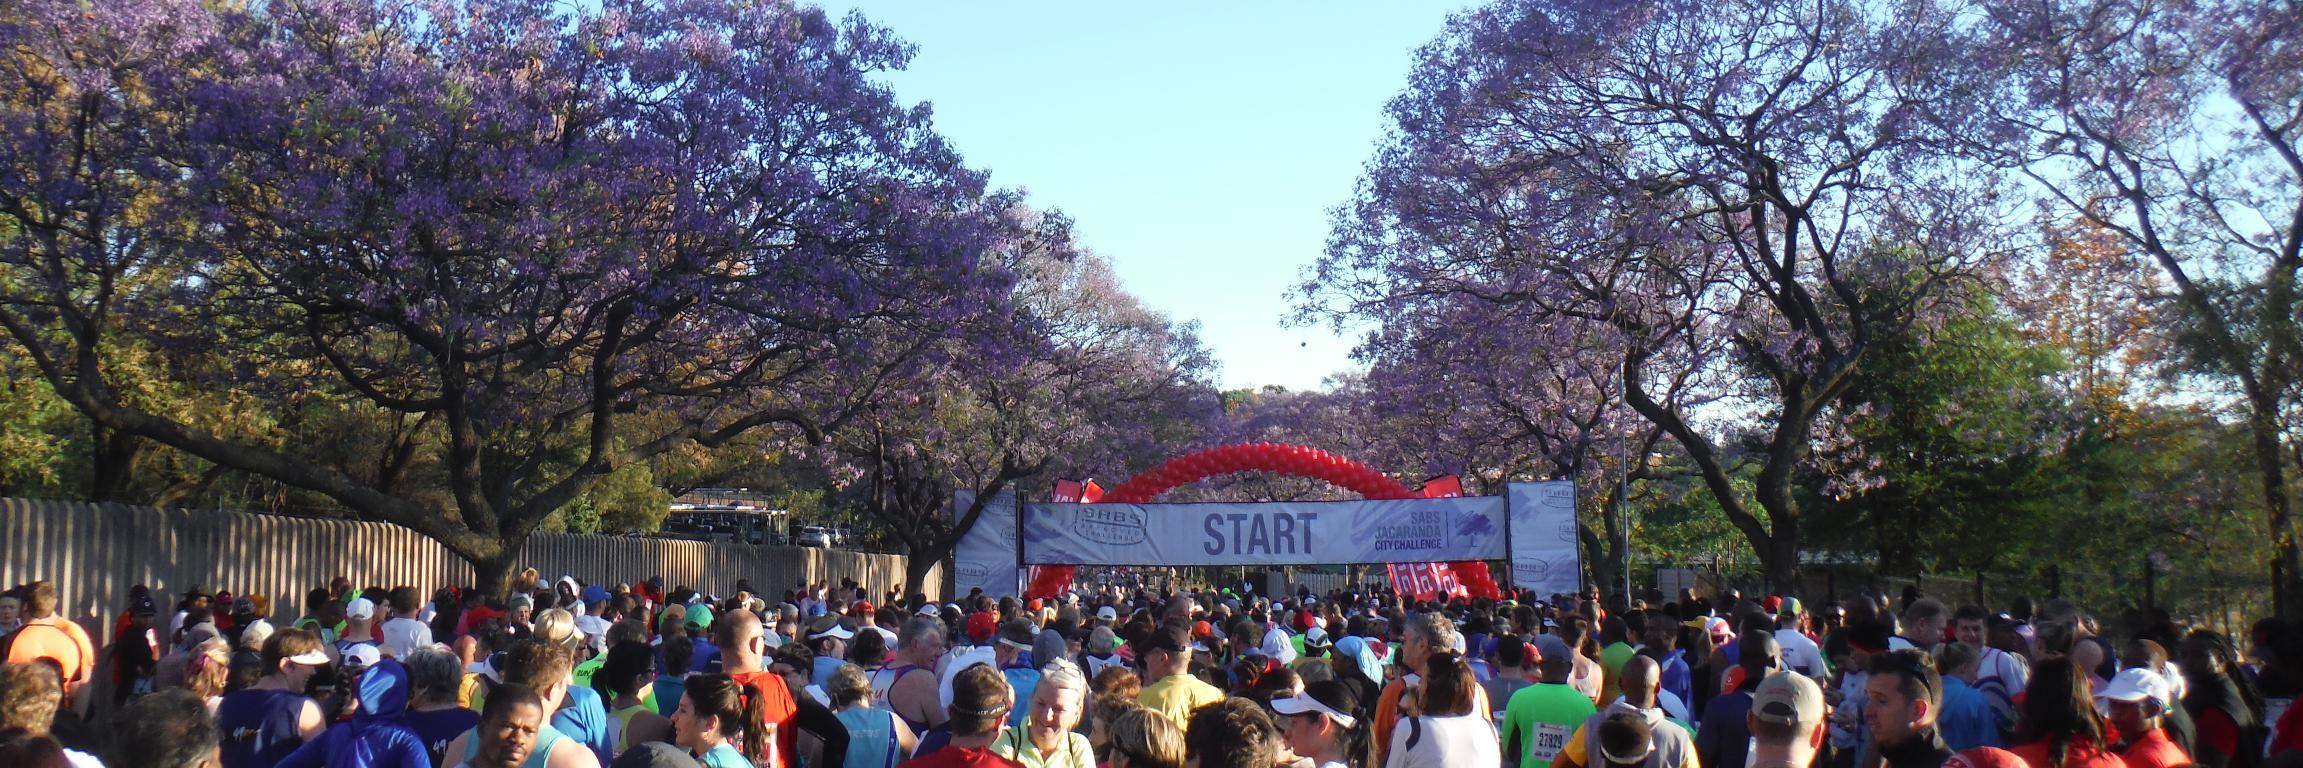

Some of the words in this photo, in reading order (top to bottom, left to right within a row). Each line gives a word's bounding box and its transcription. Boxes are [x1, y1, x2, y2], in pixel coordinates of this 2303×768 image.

[1082, 507, 1141, 525] SABS
[1410, 511, 1441, 525] SABS
[1203, 512, 1318, 556] START
[1374, 524, 1442, 540] JACARANDA
[1374, 540, 1393, 551] CITY
[1394, 539, 1442, 551] CHALLENGE
